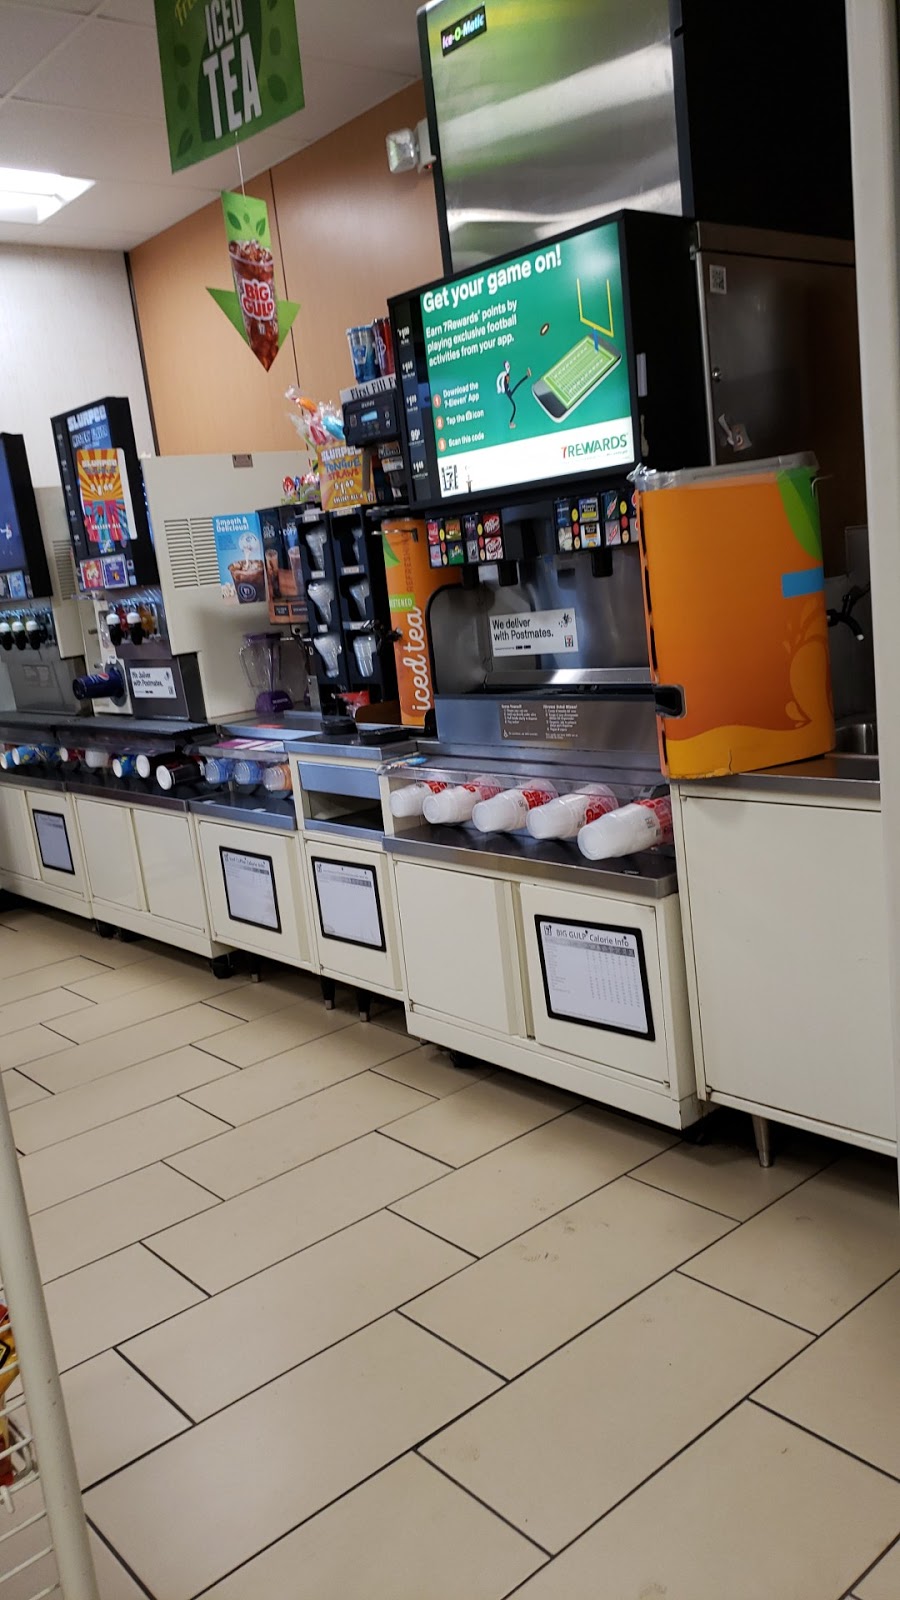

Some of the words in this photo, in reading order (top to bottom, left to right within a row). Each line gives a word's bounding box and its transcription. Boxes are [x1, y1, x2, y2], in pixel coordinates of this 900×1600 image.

[205, 0, 244, 52] ICED
[442, 13, 485, 50] Ice-O-Matic
[203, 32, 262, 139] TEA
[244, 281, 270, 301] BIG
[423, 287, 450, 313] Get
[451, 276, 485, 308] your
[487, 260, 532, 295] game
[534, 243, 562, 274] on!
[242, 297, 273, 317] GULP
[425, 324, 443, 339] Earn
[481, 303, 507, 320] points
[507, 299, 518, 313] by
[427, 335, 453, 354] playing
[453, 325, 486, 344] exclusive
[486, 313, 517, 335] football
[428, 348, 461, 368] activities
[460, 343, 479, 359] from
[479, 337, 496, 354] your
[497, 332, 515, 348] app.
[561, 434, 628, 459] 7REWARDS
[403, 606, 426, 653] tea
[492, 619, 505, 631] We
[505, 617, 531, 630] deliver
[493, 630, 509, 641] with
[510, 628, 554, 641] Postmates.
[403, 653, 431, 711] iced
[589, 933, 613, 945] Calorie
[614, 936, 630, 947] Info
